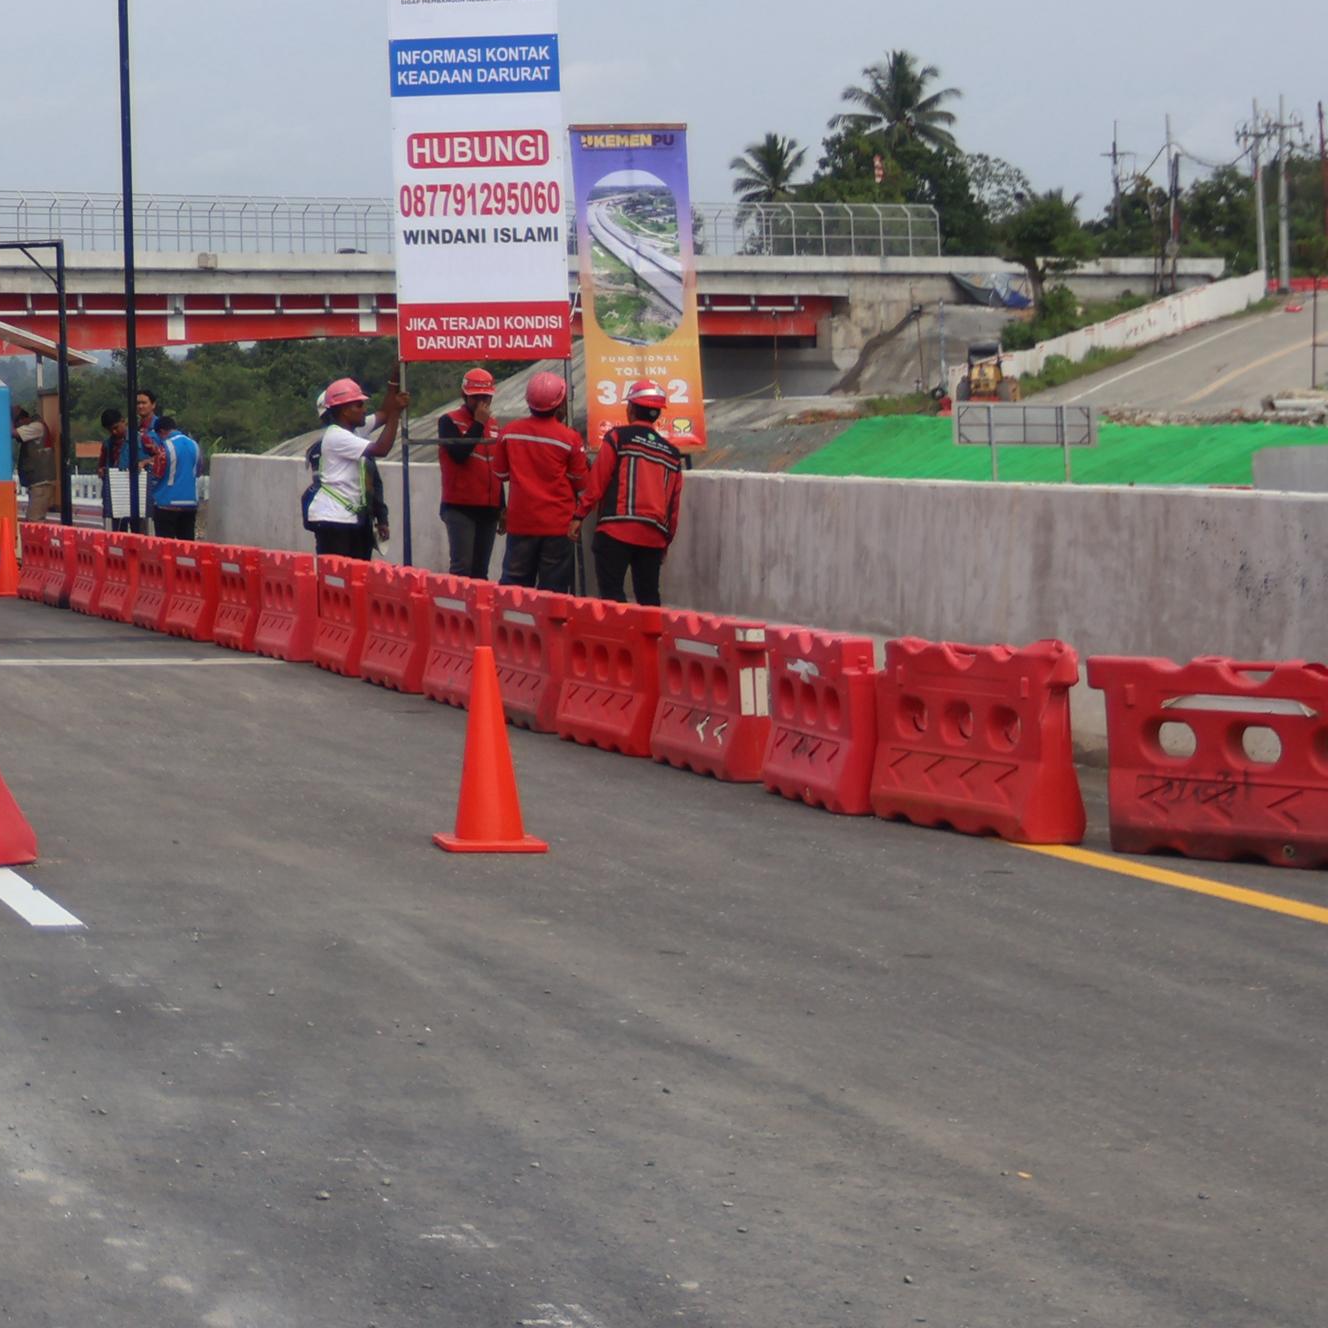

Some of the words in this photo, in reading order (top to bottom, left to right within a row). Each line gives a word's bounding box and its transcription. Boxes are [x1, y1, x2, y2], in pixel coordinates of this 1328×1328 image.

[397, 48, 481, 65] INFORMASI
[486, 45, 550, 62] KONTAK
[398, 68, 472, 85] KEADAAN
[477, 66, 551, 83] DARURAT
[412, 134, 544, 164] HUBUNGI
[594, 133, 674, 147] KEMENPU
[400, 181, 560, 217] 087791295060
[403, 228, 486, 245] WINDANI
[494, 226, 559, 243] ISLAMI
[405, 317, 437, 331] JIKA
[440, 316, 500, 330] TERJADI
[504, 315, 562, 329] KONDISI
[417, 335, 484, 349] DARURAT
[488, 335, 502, 348] DI
[506, 334, 553, 348] JALAN
[615, 367, 641, 376] TOL
[645, 366, 667, 375] IKN
